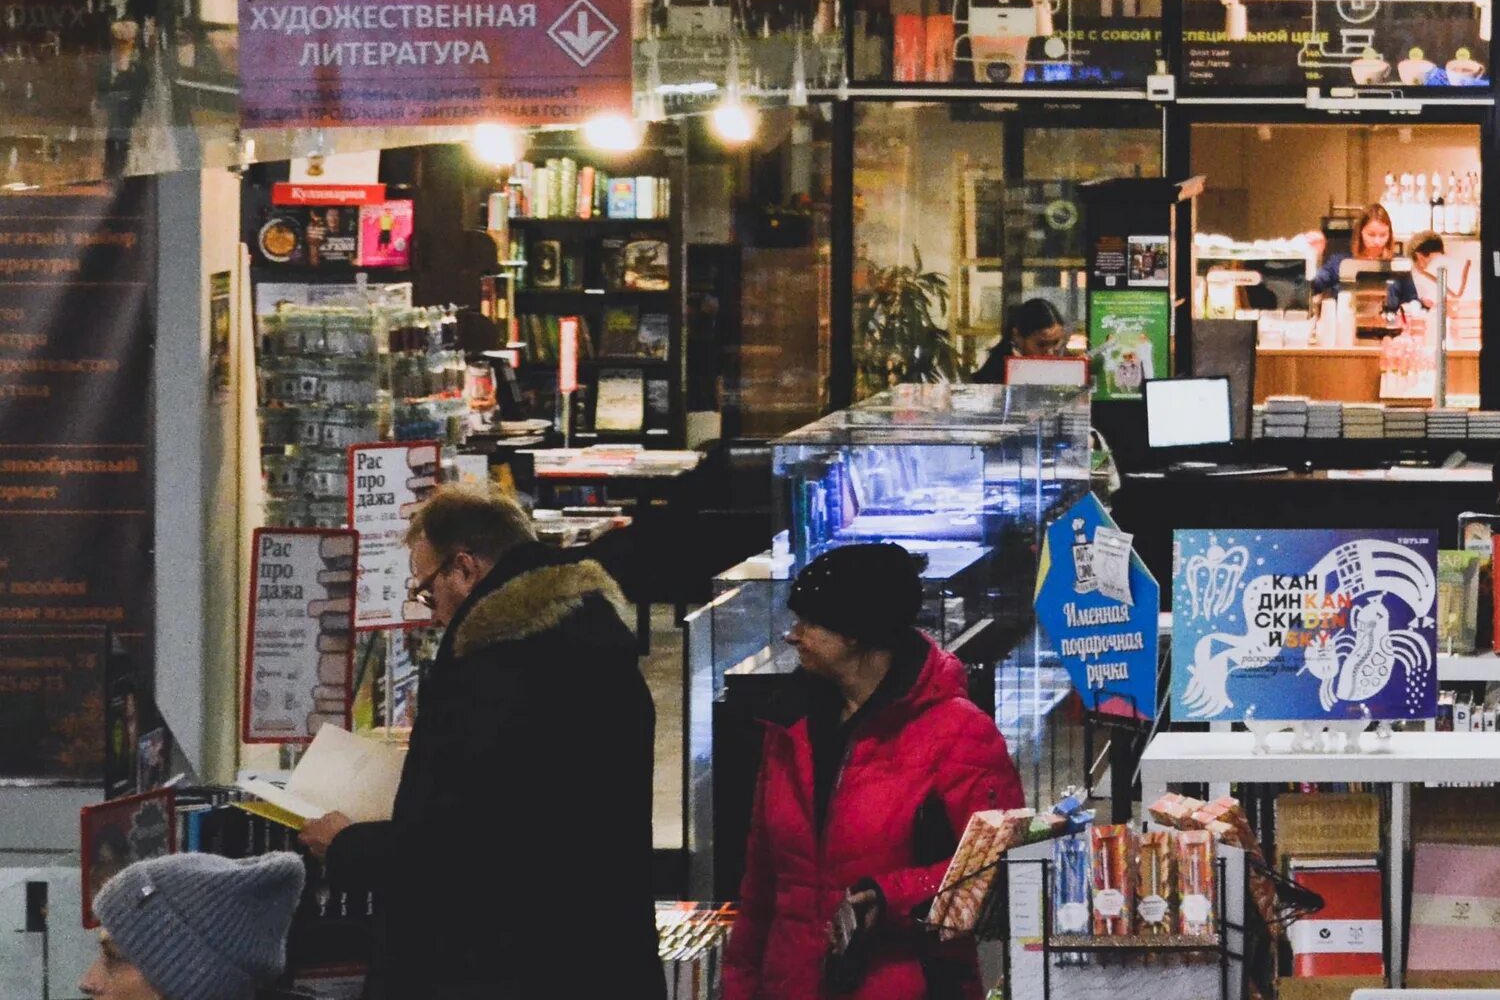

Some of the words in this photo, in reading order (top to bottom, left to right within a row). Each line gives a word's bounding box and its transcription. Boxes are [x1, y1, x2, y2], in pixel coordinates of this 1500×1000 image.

[251, 4, 537, 35] ХУДОЖЕСТВЕННАЯ
[1088, 30, 1097, 40] С
[1101, 28, 1151, 40] СОБОЙ
[299, 41, 490, 67] ЛИТЕРАТУРА
[496, 85, 579, 99] БУКИНИСТ
[308, 106, 404, 121] ПРОДУКЦИЯ
[1, 457, 138, 476] знообразный
[357, 453, 383, 471] Рас
[357, 474, 386, 493] про
[356, 491, 396, 508] дажа
[262, 537, 292, 558] Рас
[261, 562, 294, 582] про
[1272, 574, 1317, 590] КАН
[259, 583, 303, 602] дажа
[1258, 594, 1302, 611] ДИН
[1304, 593, 1353, 610] KAN
[1063, 602, 1131, 627] Именная
[1254, 612, 1302, 629] СКИ
[1304, 612, 1347, 629] DIN
[1061, 631, 1144, 662] подарочная
[1269, 631, 1282, 647] Й
[1285, 631, 1331, 648] SKY
[1086, 662, 1129, 689] ручка
